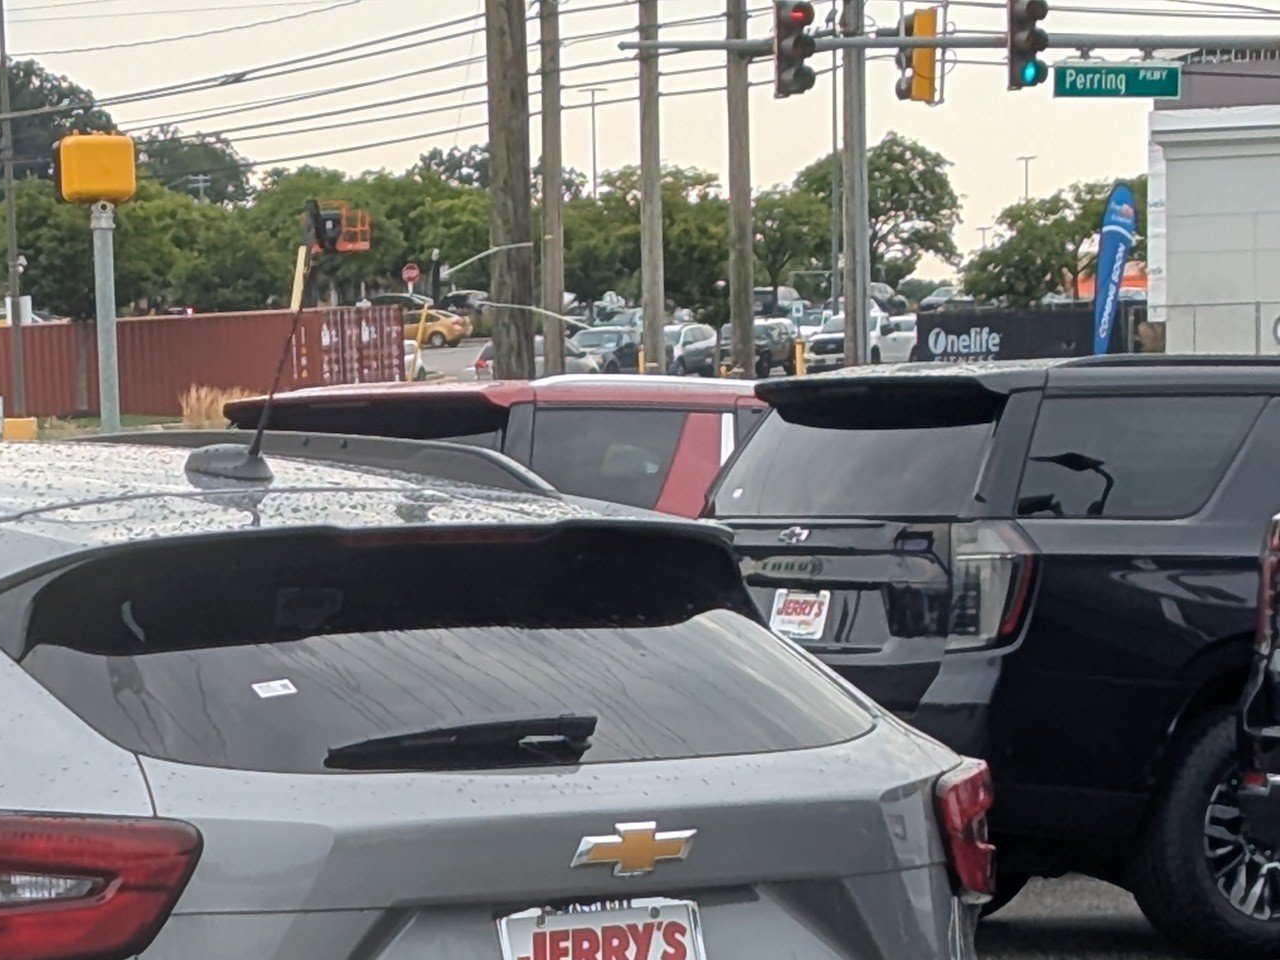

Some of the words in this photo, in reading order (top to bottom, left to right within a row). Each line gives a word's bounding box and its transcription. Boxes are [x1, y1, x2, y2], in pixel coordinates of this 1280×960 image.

[1065, 69, 1127, 95] Perring
[928, 327, 1000, 354] Onelife
[776, 599, 824, 618] JERRY'S
